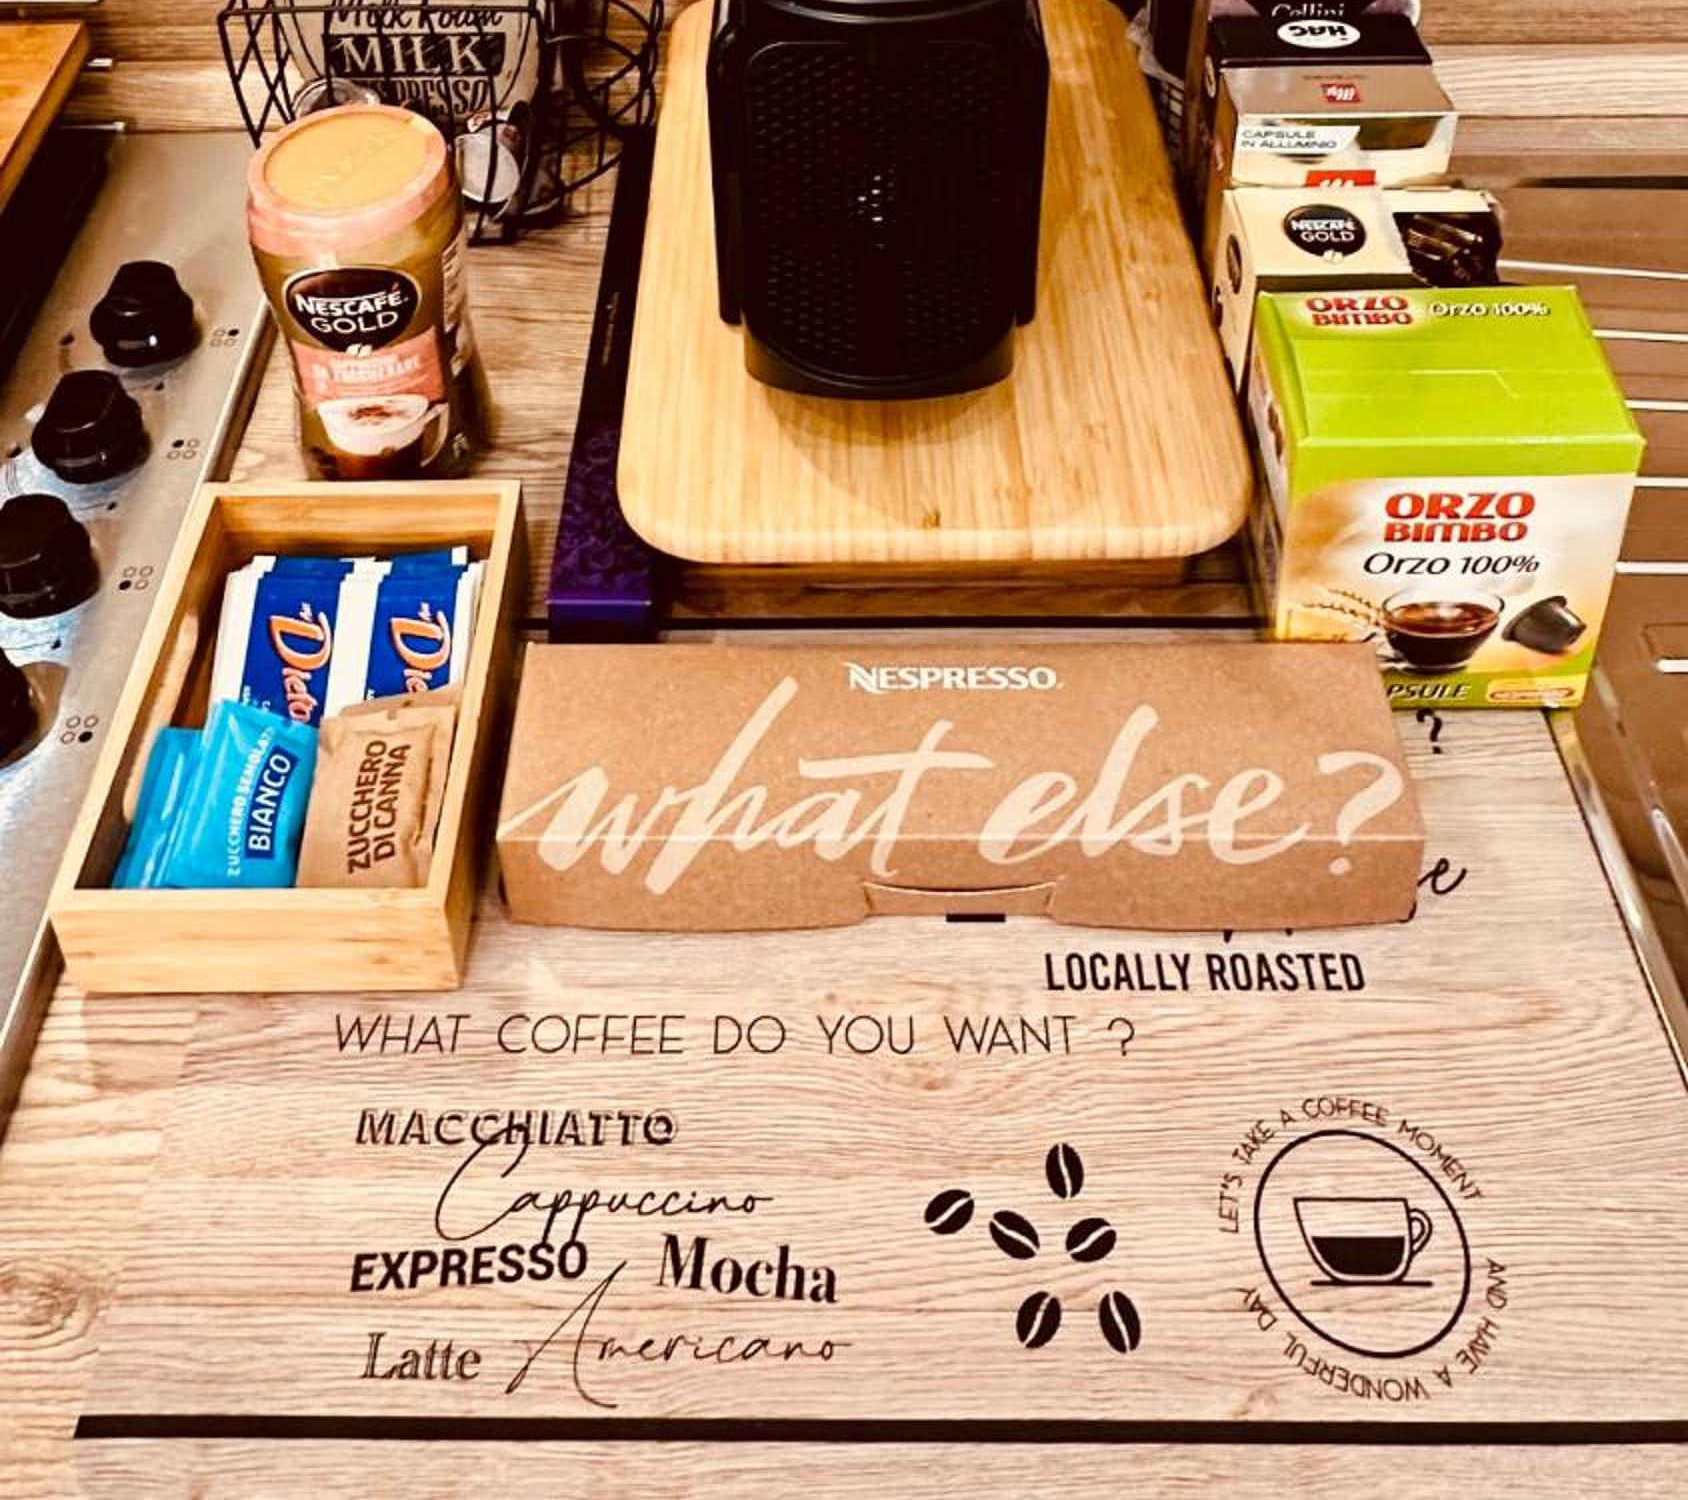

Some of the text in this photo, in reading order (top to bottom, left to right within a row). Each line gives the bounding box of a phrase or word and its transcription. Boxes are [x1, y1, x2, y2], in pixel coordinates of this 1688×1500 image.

[339, 36, 487, 74] MILK
[1241, 140, 1256, 148] IN
[1242, 129, 1316, 139] CAPSULE
[1300, 231, 1355, 242] GOLD
[311, 311, 399, 334] GOLD
[1306, 296, 1409, 312] ORZO
[1312, 312, 1413, 326] BIMBO
[1429, 301, 1551, 317] Orzo 100%
[1385, 492, 1536, 520] ORZO
[1383, 521, 1529, 543] BIMBO
[1363, 551, 1541, 575] Orzo 100%
[842, 661, 1058, 695] NESPRESSO
[248, 753, 292, 851] BIANCO
[373, 744, 411, 862] DI CANNA
[496, 676, 1405, 895] what else?
[347, 740, 387, 874] ZUCCHERO
[226, 797, 248, 877] ZUCCHERO
[1045, 952, 1366, 993] LOCALLY ROASTED
[335, 1014, 1136, 1057] WHAT COFFEE DO YOU WANT ?
[354, 1108, 680, 1148] MACCHIATTO
[435, 1122, 774, 1246] Cappuccino
[1219, 1097, 1483, 1234] LET'S TAKE A COFFEE MOMENT
[350, 1240, 588, 1292] EXPRESSO
[657, 1232, 839, 1304] Mocha
[505, 1260, 855, 1408] Americano
[1235, 1256, 1509, 1402] AND HAVE A WONDERFUL DAY
[359, 1331, 482, 1381] Latte
